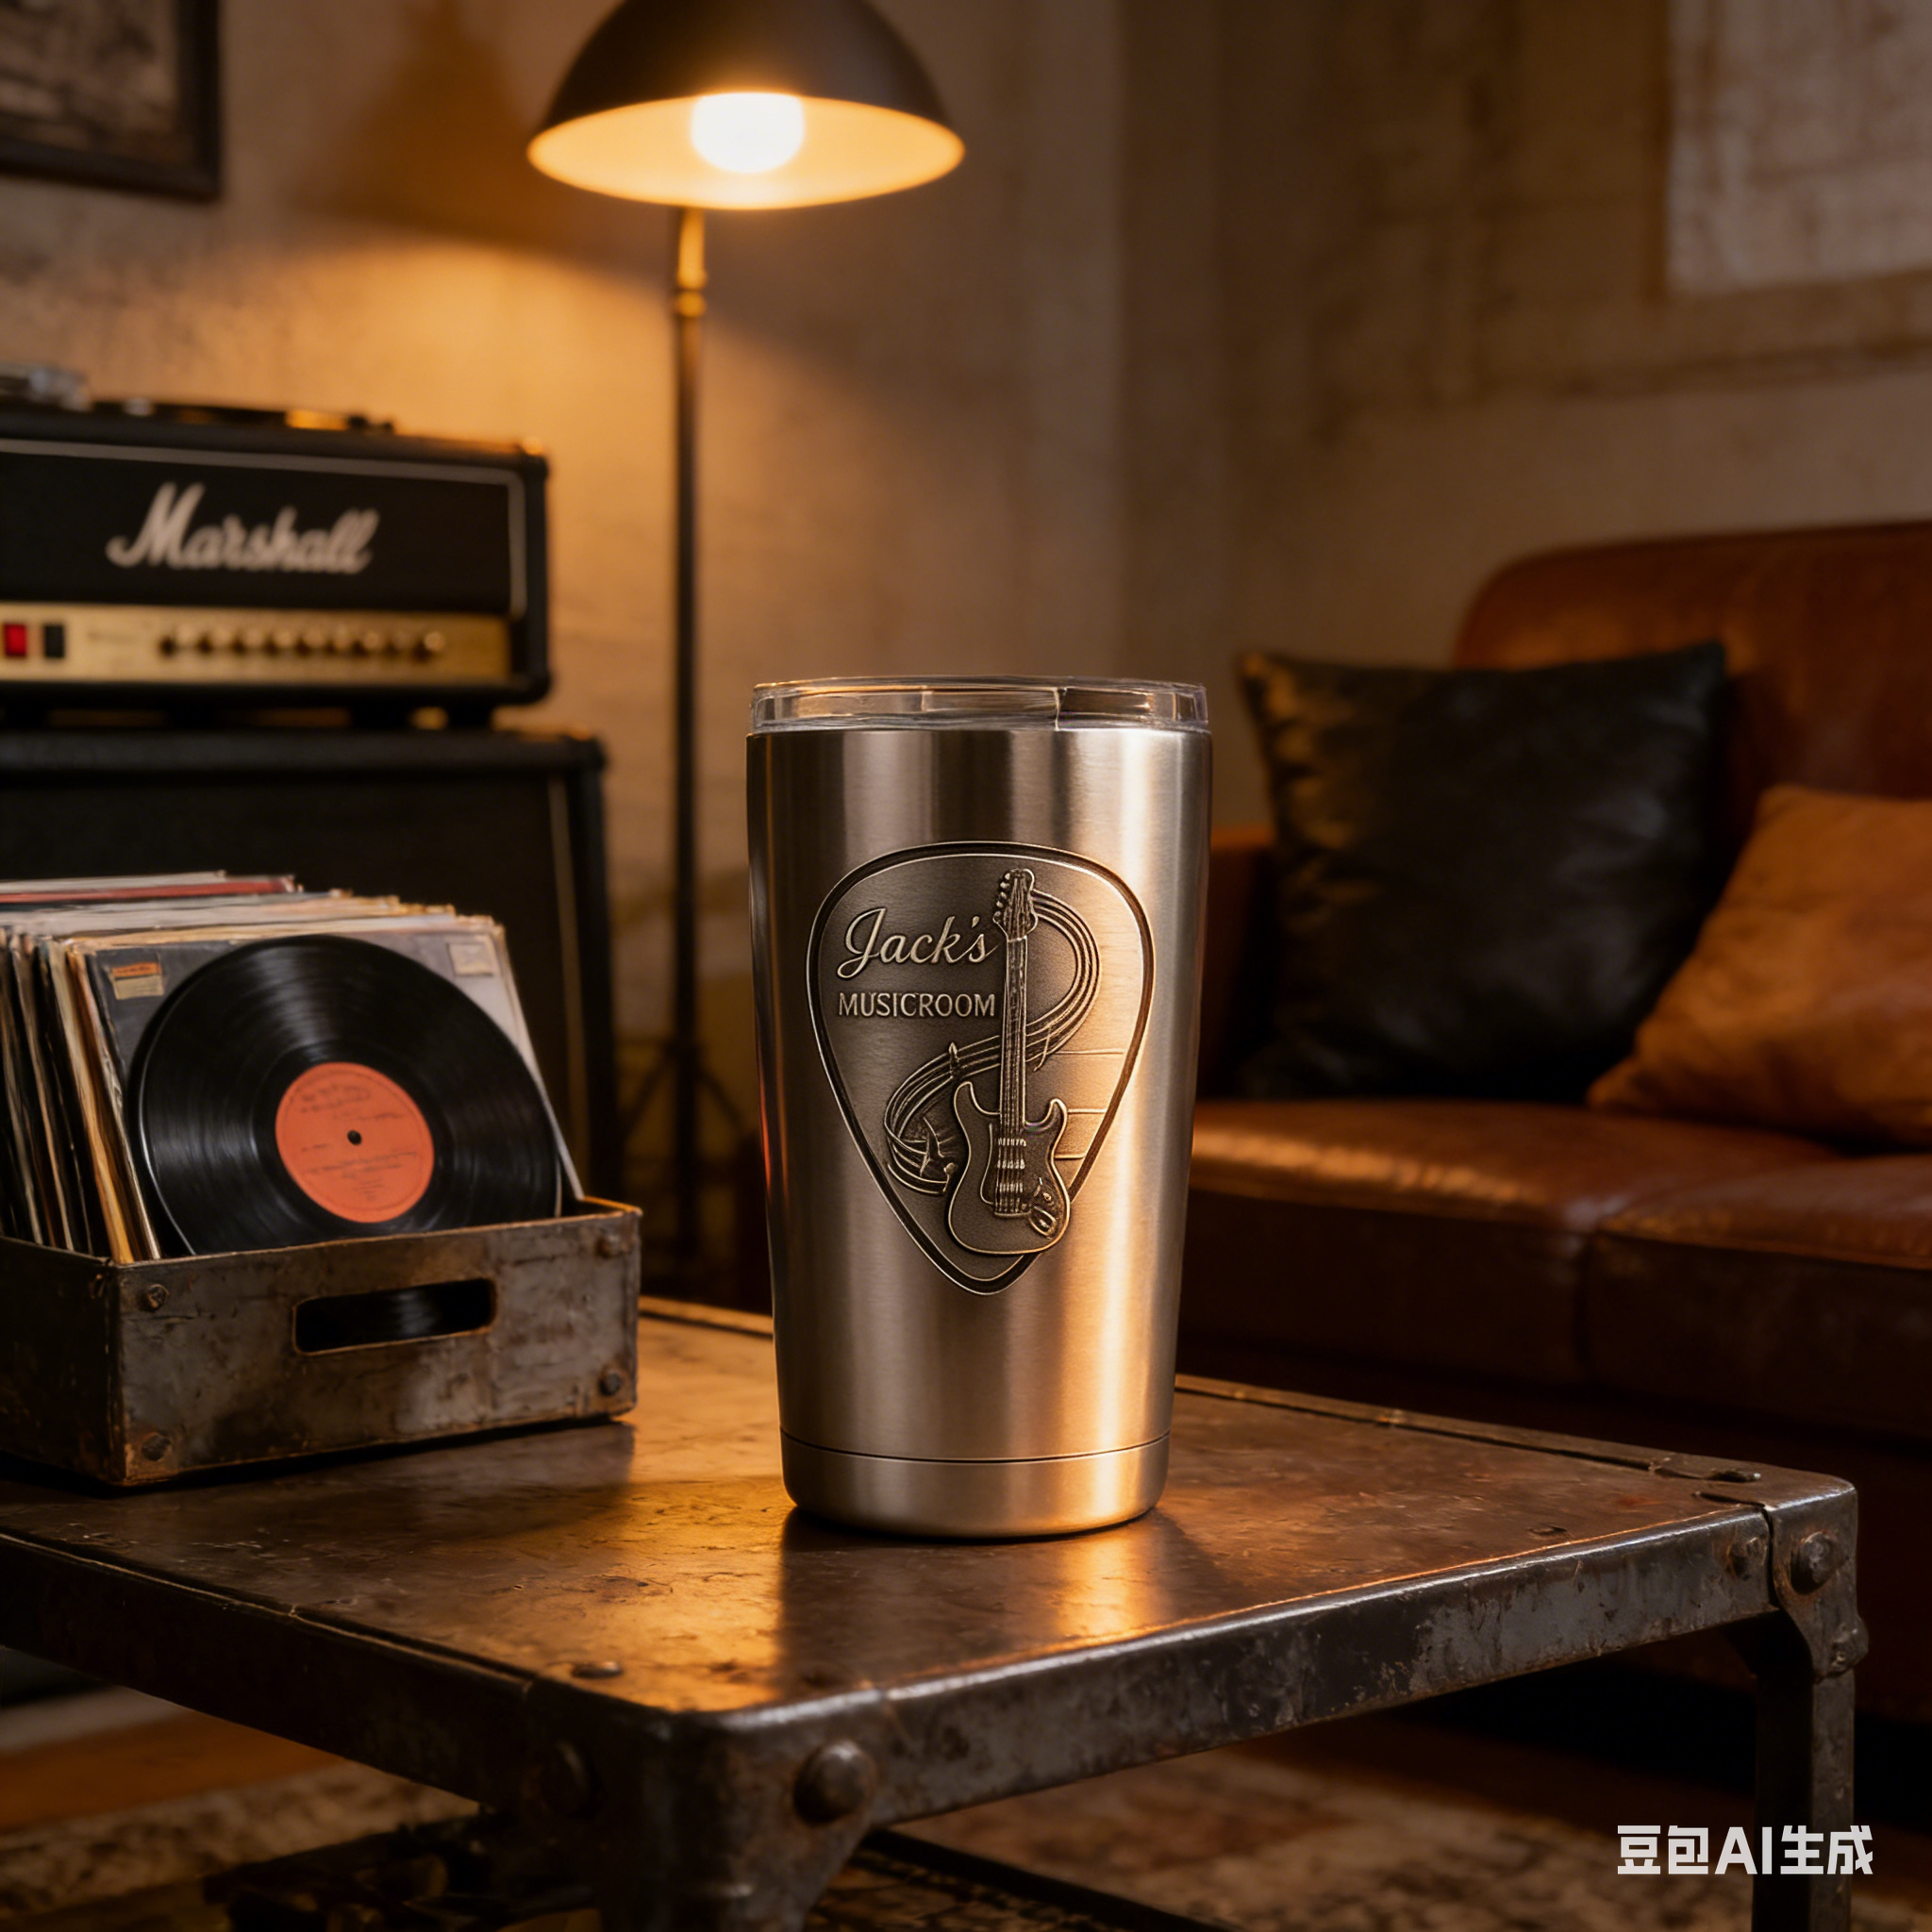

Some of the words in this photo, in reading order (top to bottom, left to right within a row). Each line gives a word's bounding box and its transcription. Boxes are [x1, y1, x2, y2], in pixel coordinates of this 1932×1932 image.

[106, 482, 378, 574] Marshall
[837, 907, 998, 978] Jack's
[838, 992, 995, 1017] MUSICROOM
